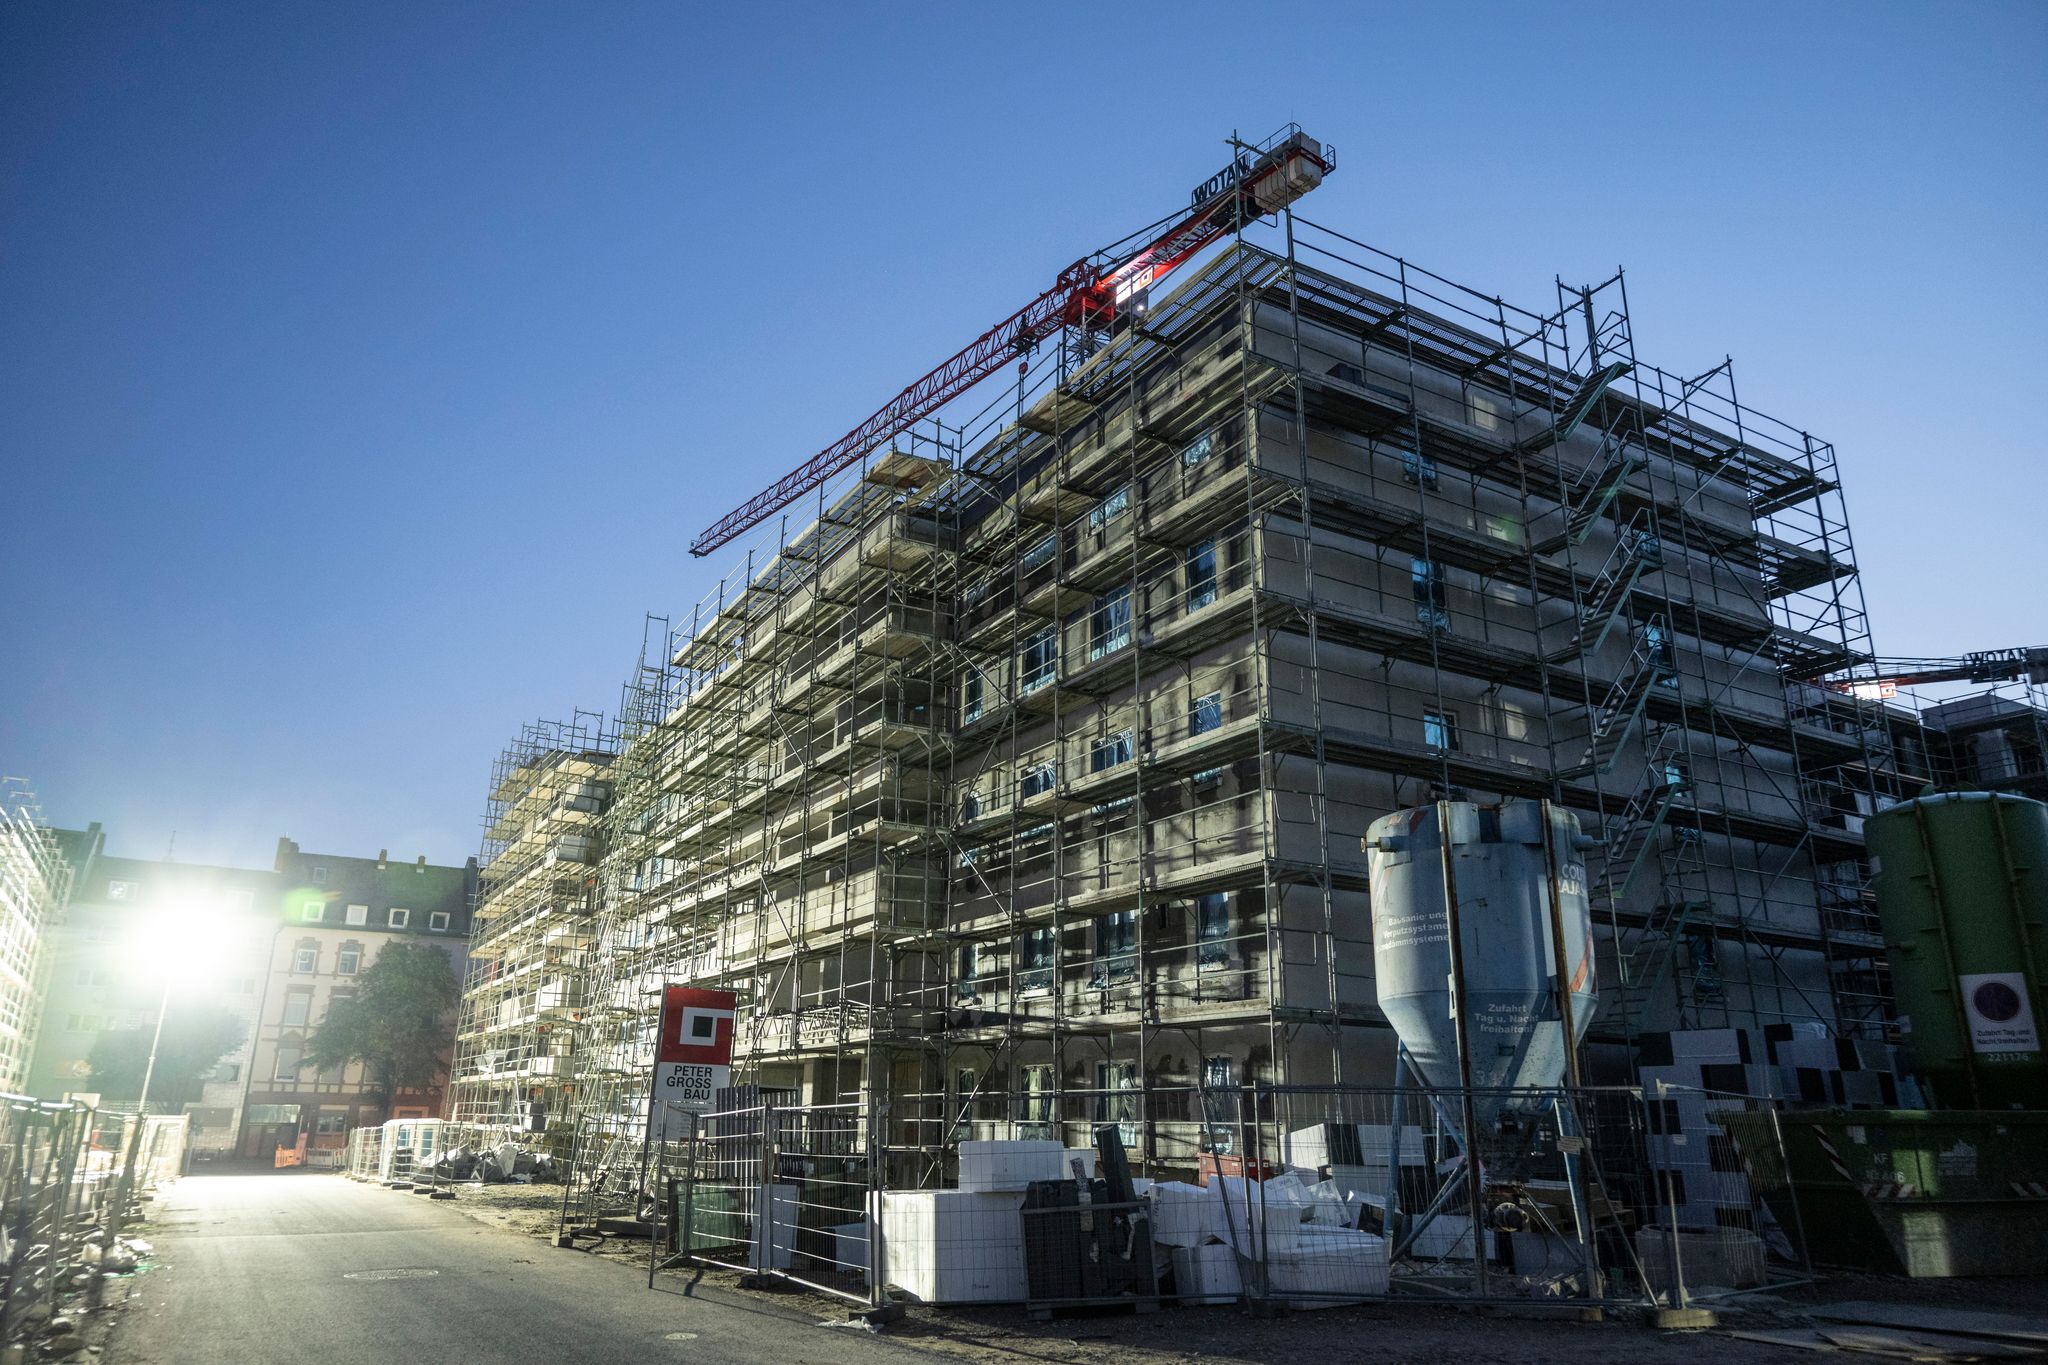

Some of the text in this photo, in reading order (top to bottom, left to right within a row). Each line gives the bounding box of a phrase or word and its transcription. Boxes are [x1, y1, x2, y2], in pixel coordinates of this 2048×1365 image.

[1195, 155, 1248, 203] WOTAN
[1968, 648, 2028, 664] WOTAN
[1487, 1003, 1527, 1013] Zufahrt
[1474, 1013, 1493, 1024] Tag
[1509, 1014, 1539, 1023] Nacht
[674, 1066, 712, 1077] PETER
[667, 1076, 711, 1088] GROSS
[684, 1089, 710, 1100] BAU
